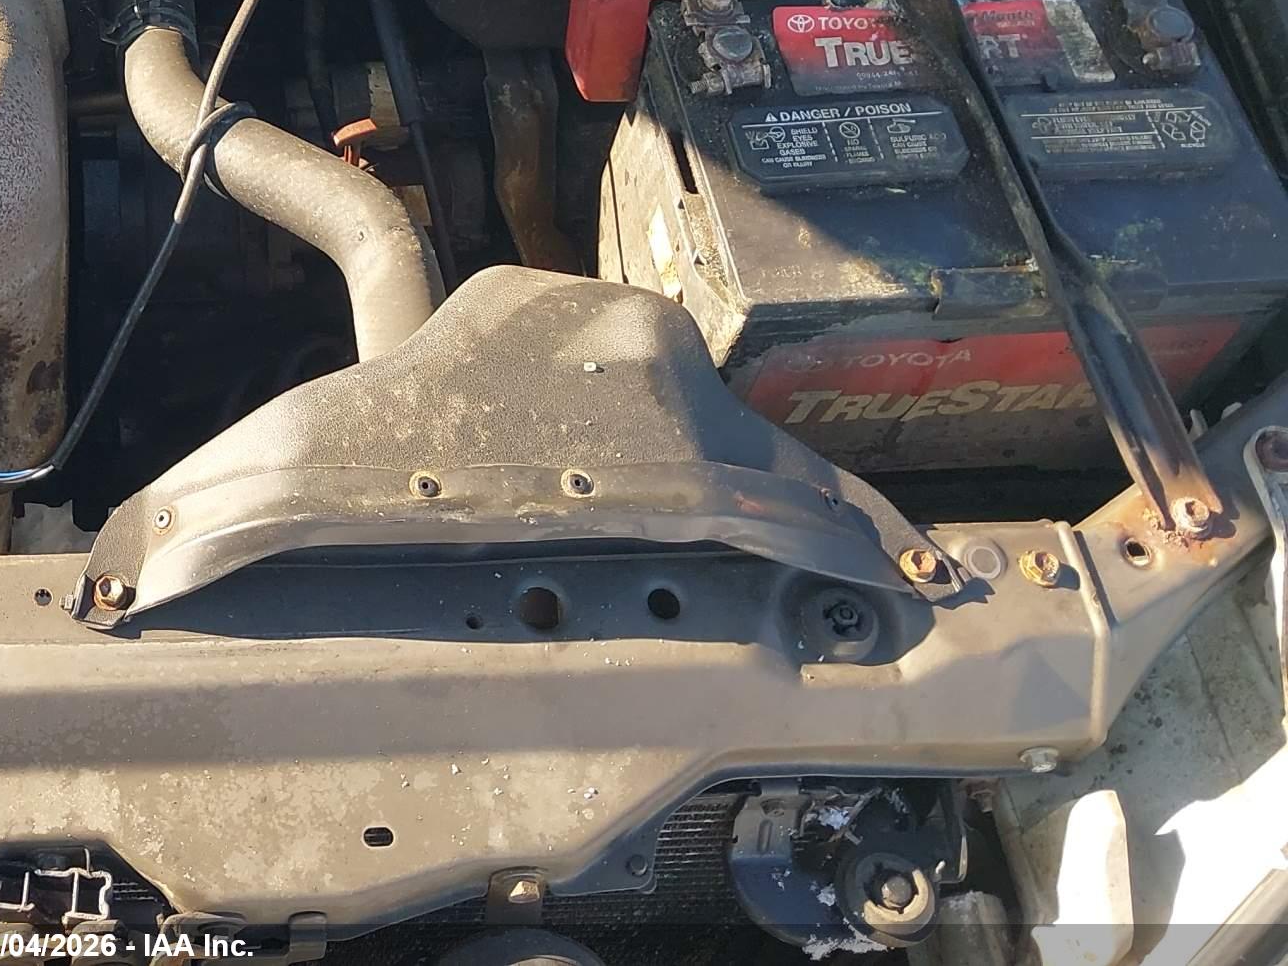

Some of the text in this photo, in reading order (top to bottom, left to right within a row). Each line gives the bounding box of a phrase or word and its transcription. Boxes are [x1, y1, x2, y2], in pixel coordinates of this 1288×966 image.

[779, 108, 841, 122] DANGER
[855, 103, 912, 117] POISON
[777, 141, 818, 149] EXPLOSIVE
[843, 349, 972, 370] TOYOTA
